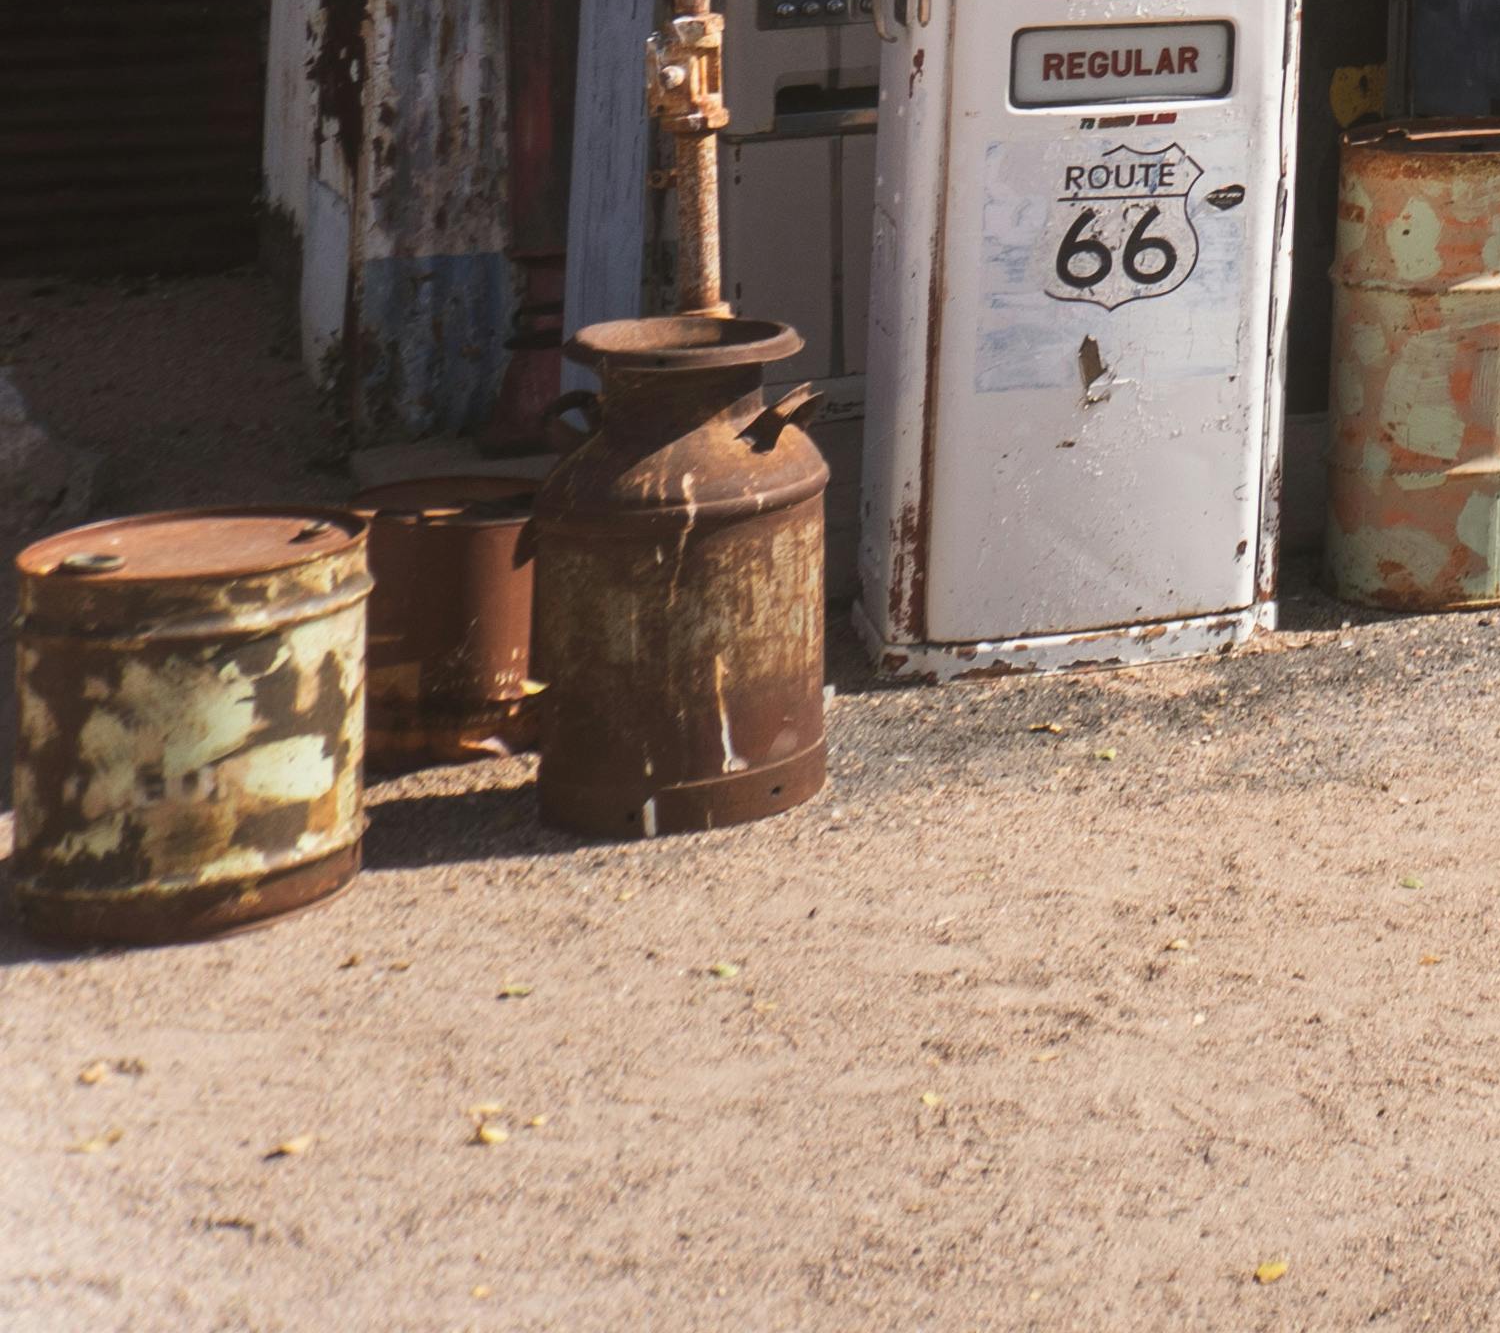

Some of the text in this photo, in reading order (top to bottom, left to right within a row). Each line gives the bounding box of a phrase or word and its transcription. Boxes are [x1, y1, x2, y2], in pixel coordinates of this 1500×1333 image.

[1042, 45, 1200, 83] REGULAR
[1064, 162, 1177, 192] ROUTE
[1055, 204, 1178, 290] 66
